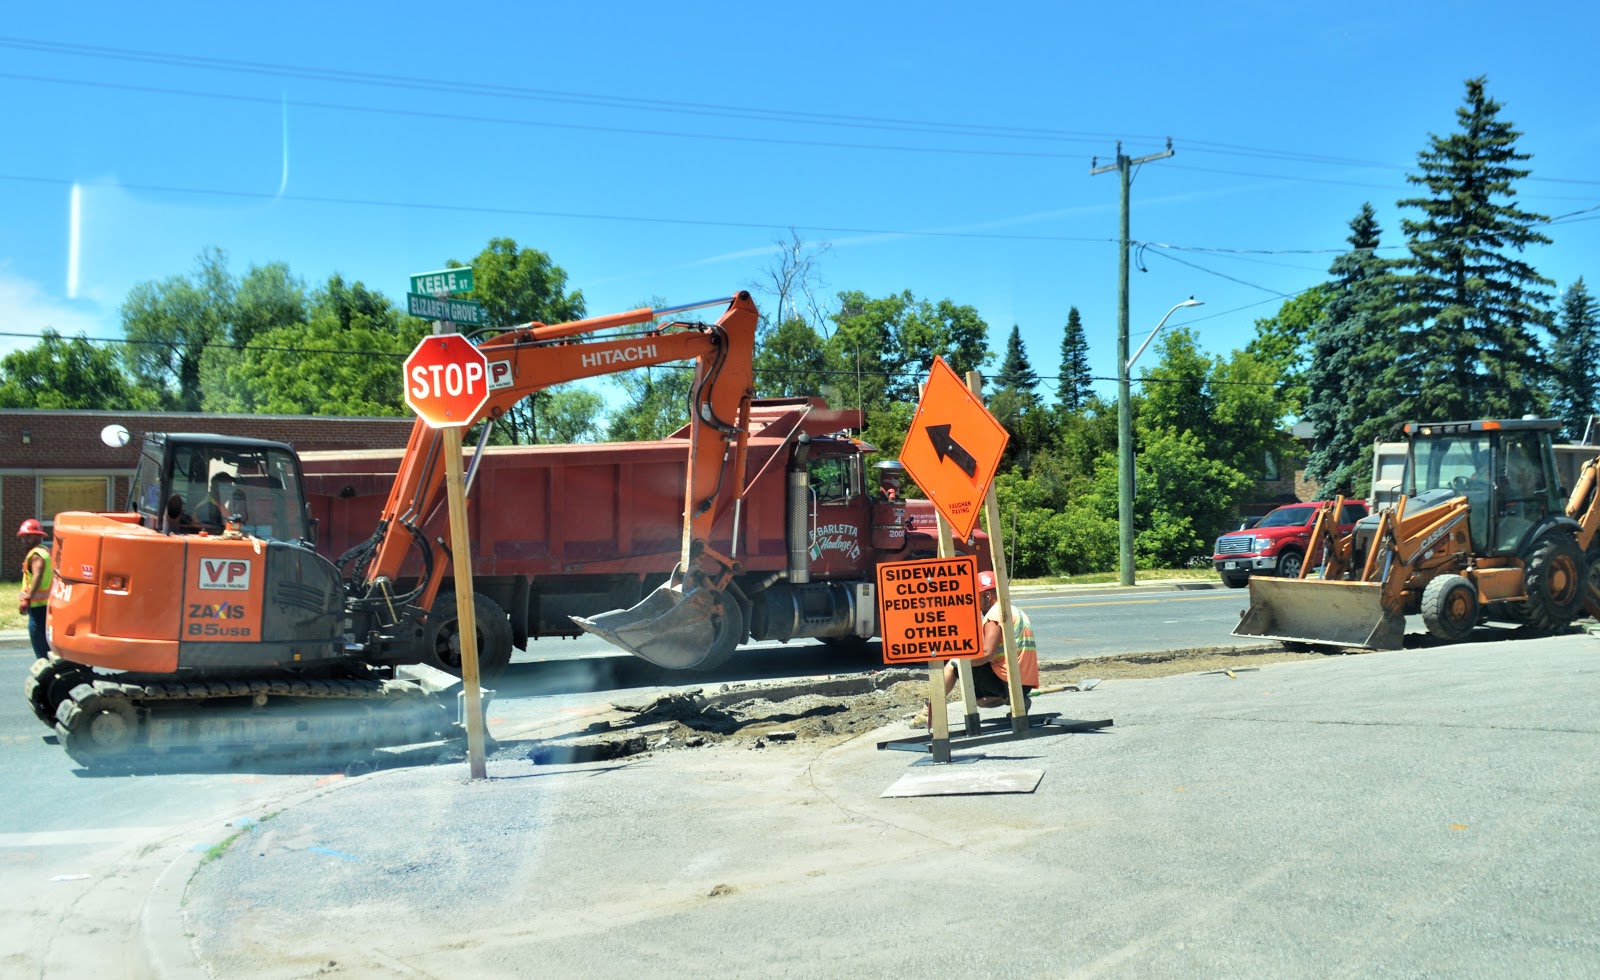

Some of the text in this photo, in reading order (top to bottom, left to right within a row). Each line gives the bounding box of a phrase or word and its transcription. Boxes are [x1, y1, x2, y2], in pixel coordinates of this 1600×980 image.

[416, 273, 468, 295] KEELE ST
[411, 296, 478, 322] ELIZABETH GROVE
[581, 344, 658, 368] HITACHI
[411, 361, 483, 399] STOP
[948, 501, 971, 509] VAUGHAN
[951, 507, 970, 515] PAVING
[894, 516, 902, 525] 4
[816, 523, 858, 538] BARLETTA
[1421, 525, 1446, 549] CASE
[204, 560, 247, 584] VP
[885, 563, 969, 582] SIDEWALK
[896, 579, 960, 596] CLOSED
[188, 601, 245, 620] ZAXIS
[885, 593, 974, 612] PEDESTRIANS
[914, 610, 946, 624] USE
[904, 624, 959, 640] OTHER
[891, 638, 974, 656] SIDEWALK
